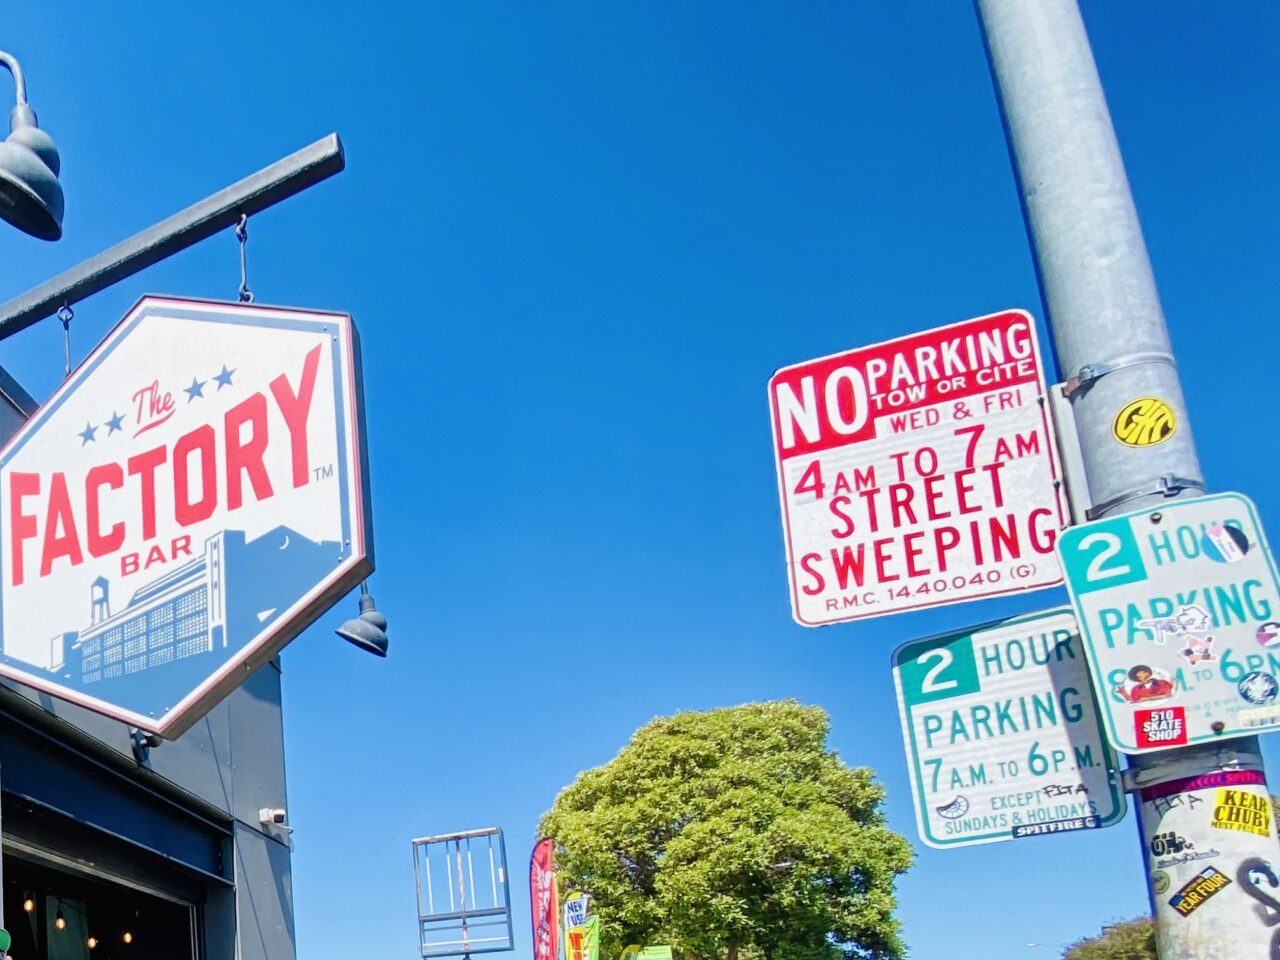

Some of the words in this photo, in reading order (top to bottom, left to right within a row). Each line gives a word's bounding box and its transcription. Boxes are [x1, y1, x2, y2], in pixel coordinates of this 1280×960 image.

[132, 380, 176, 428] The
[776, 366, 869, 449] NO
[865, 323, 1030, 394] PARKING
[871, 384, 926, 410] TOW
[937, 376, 966, 393] OR
[977, 359, 1034, 385] CITE
[891, 409, 940, 433] WED
[953, 401, 970, 420] &
[984, 391, 1023, 413] FRI
[9, 342, 322, 587] FACTORY
[890, 447, 938, 481] TO
[829, 462, 1005, 538] STREET
[120, 534, 193, 578] BAR
[800, 508, 1056, 596] SWEEPING
[1078, 532, 1131, 582] 2
[1148, 519, 1244, 566] HO
[826, 592, 880, 612] R.M.C.
[887, 570, 1001, 600] 14.40.040
[1010, 564, 1037, 580] (G)
[917, 648, 958, 693] 2
[980, 629, 1076, 677] HOUR
[923, 687, 1083, 748] PARKING
[1143, 718, 1182, 732] SKATE
[1148, 730, 1181, 742] SHOP
[1150, 710, 1174, 721] 510
[998, 760, 1019, 778] TO
[945, 812, 1008, 835] SUNDAYS
[1012, 812, 1024, 825] &
[1027, 801, 1098, 825] HOLIDAYS
[991, 790, 1041, 811] EXCEPT
[1016, 818, 1085, 837] SPITFIRE
[1176, 892, 1203, 912] YEAR
[1196, 874, 1228, 896] FOUR
